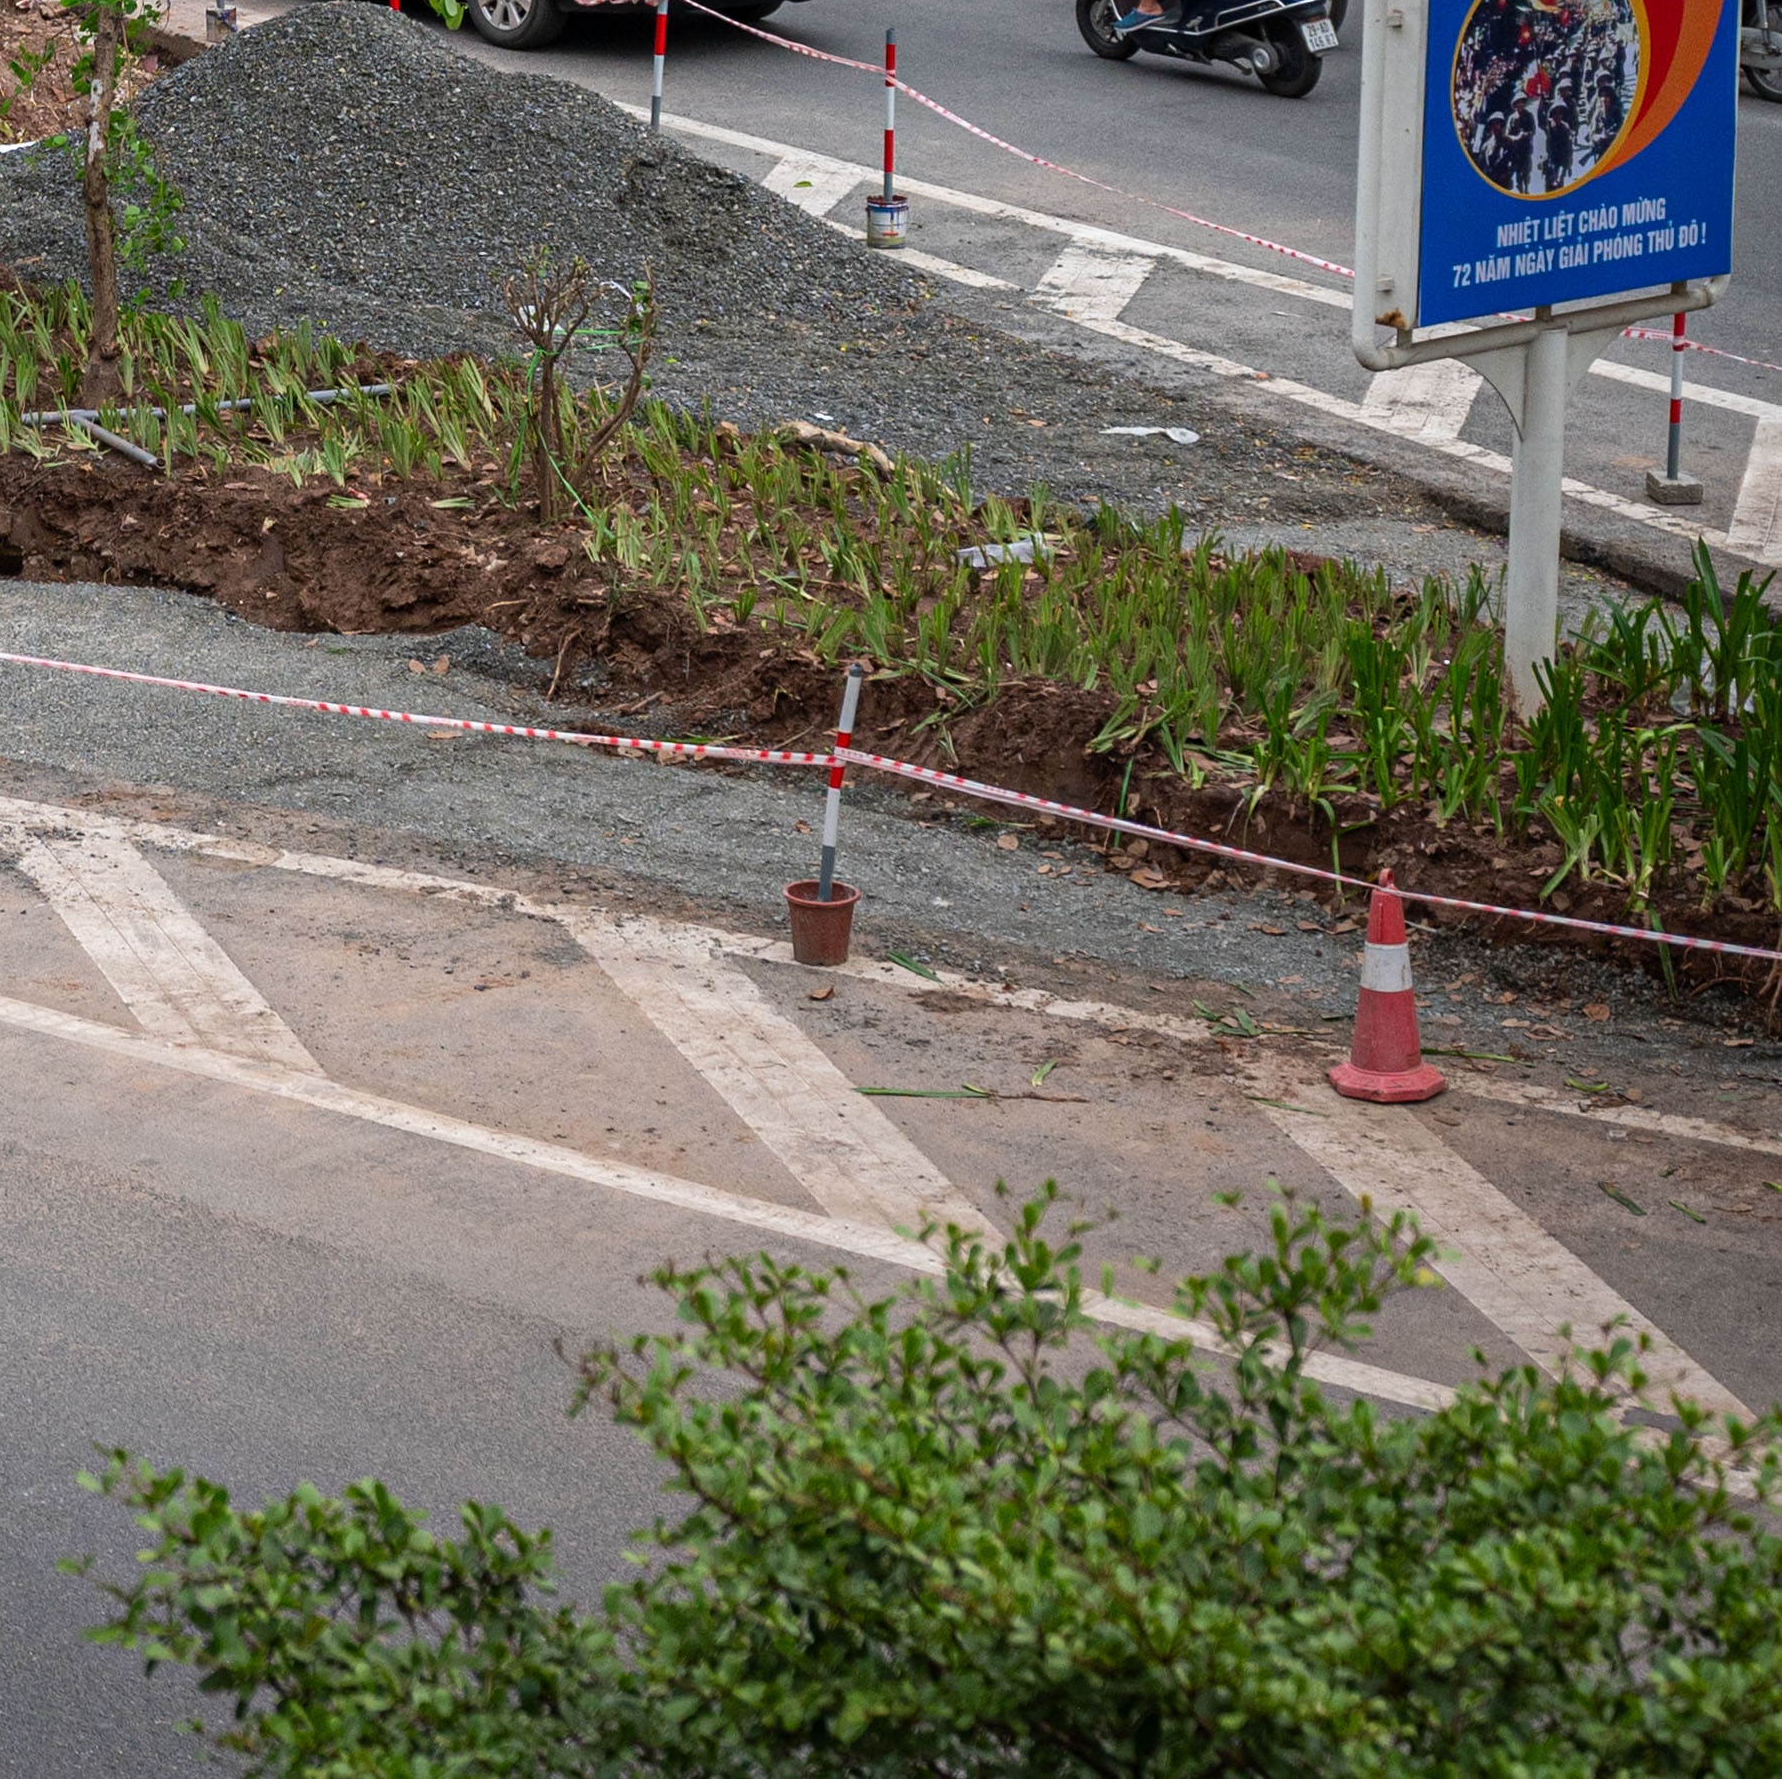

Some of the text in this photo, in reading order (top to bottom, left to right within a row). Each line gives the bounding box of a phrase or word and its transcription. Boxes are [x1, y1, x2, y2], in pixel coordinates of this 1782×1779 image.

[1496, 195, 1666, 249] NHIỆT LIỆT CHÀO MỪNG
[1452, 263, 1471, 288] 72
[1475, 254, 1511, 284] NĂM
[1515, 245, 1554, 277] NGÀY
[1558, 235, 1589, 270] GIẢI
[1593, 231, 1643, 264] PHÓNG
[1647, 220, 1675, 254] THỦ
